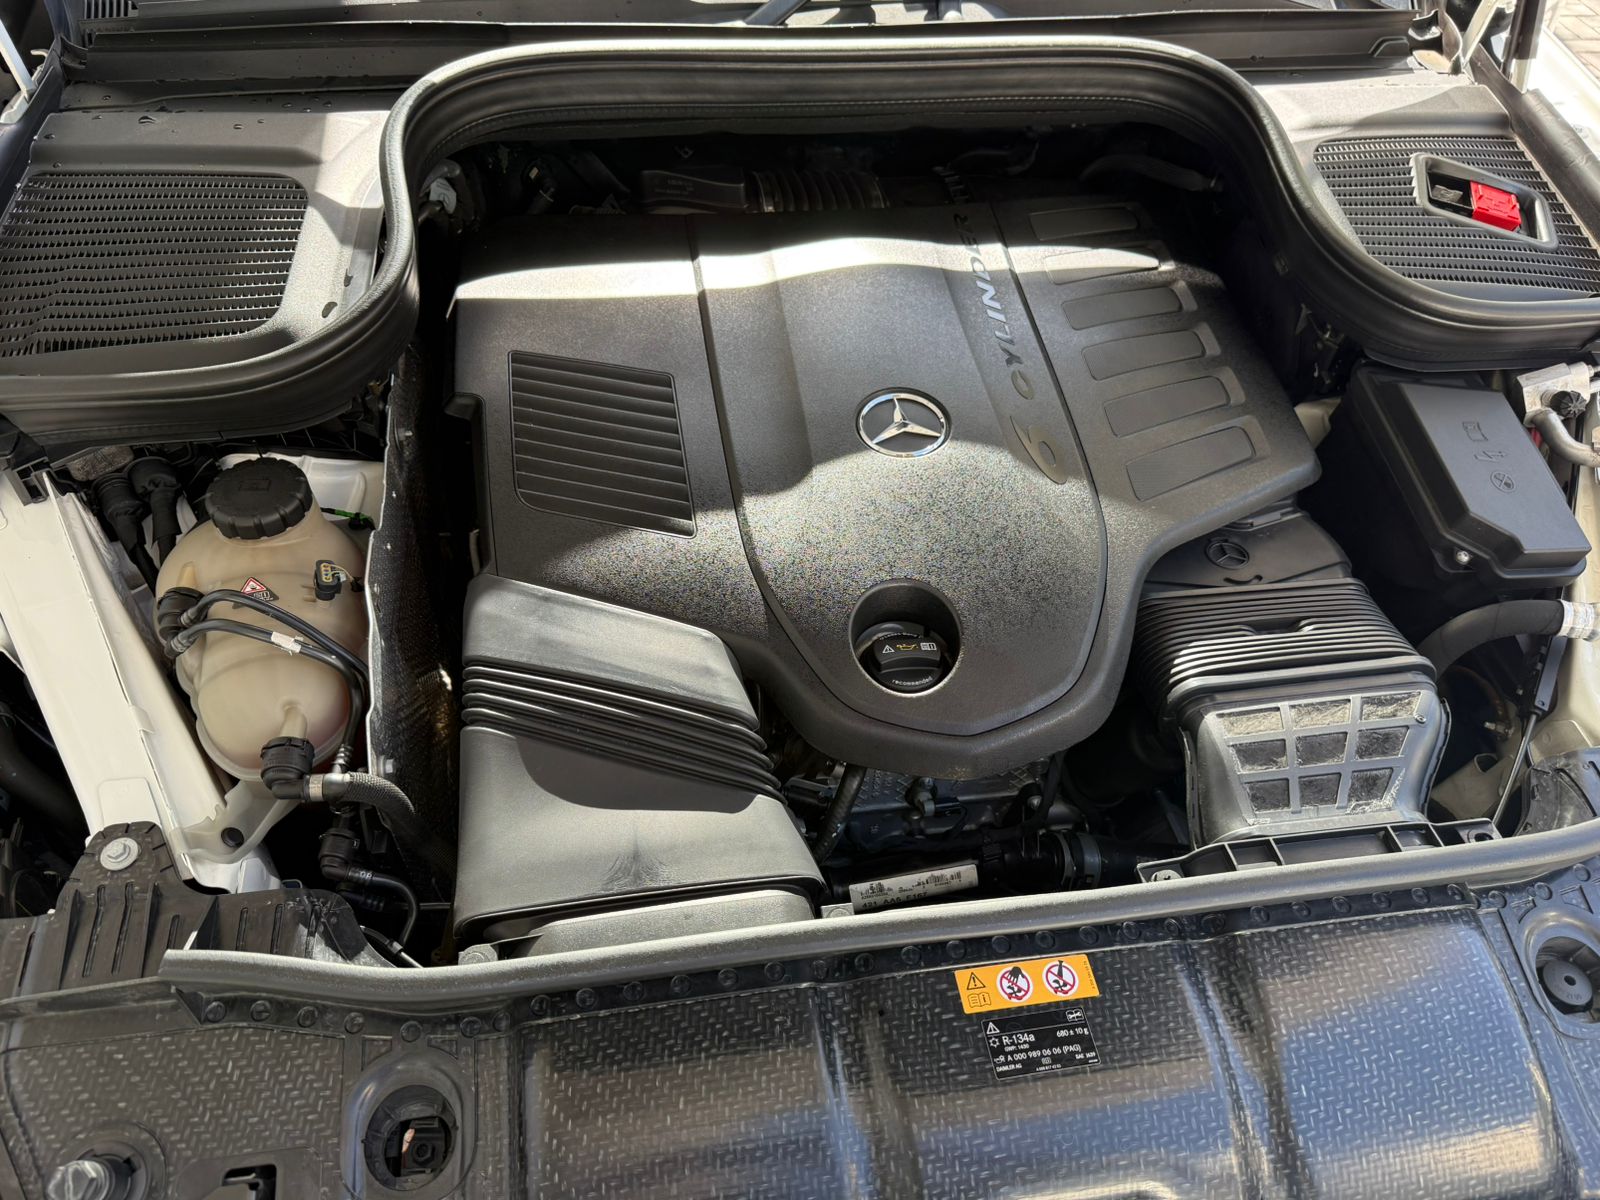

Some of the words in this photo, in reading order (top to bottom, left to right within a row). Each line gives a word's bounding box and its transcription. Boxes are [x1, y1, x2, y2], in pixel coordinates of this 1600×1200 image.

[953, 213, 1036, 400] CYLINDER
[1010, 414, 1068, 485] 6
[891, 675, 933, 686] recommended
[1002, 1033, 1036, 1046] R-134a
[1028, 1050, 1041, 1058] 989
[1042, 1048, 1052, 1056] 06
[1062, 1044, 1082, 1054] (PAG)
[995, 1064, 1015, 1072] DAIMLER
